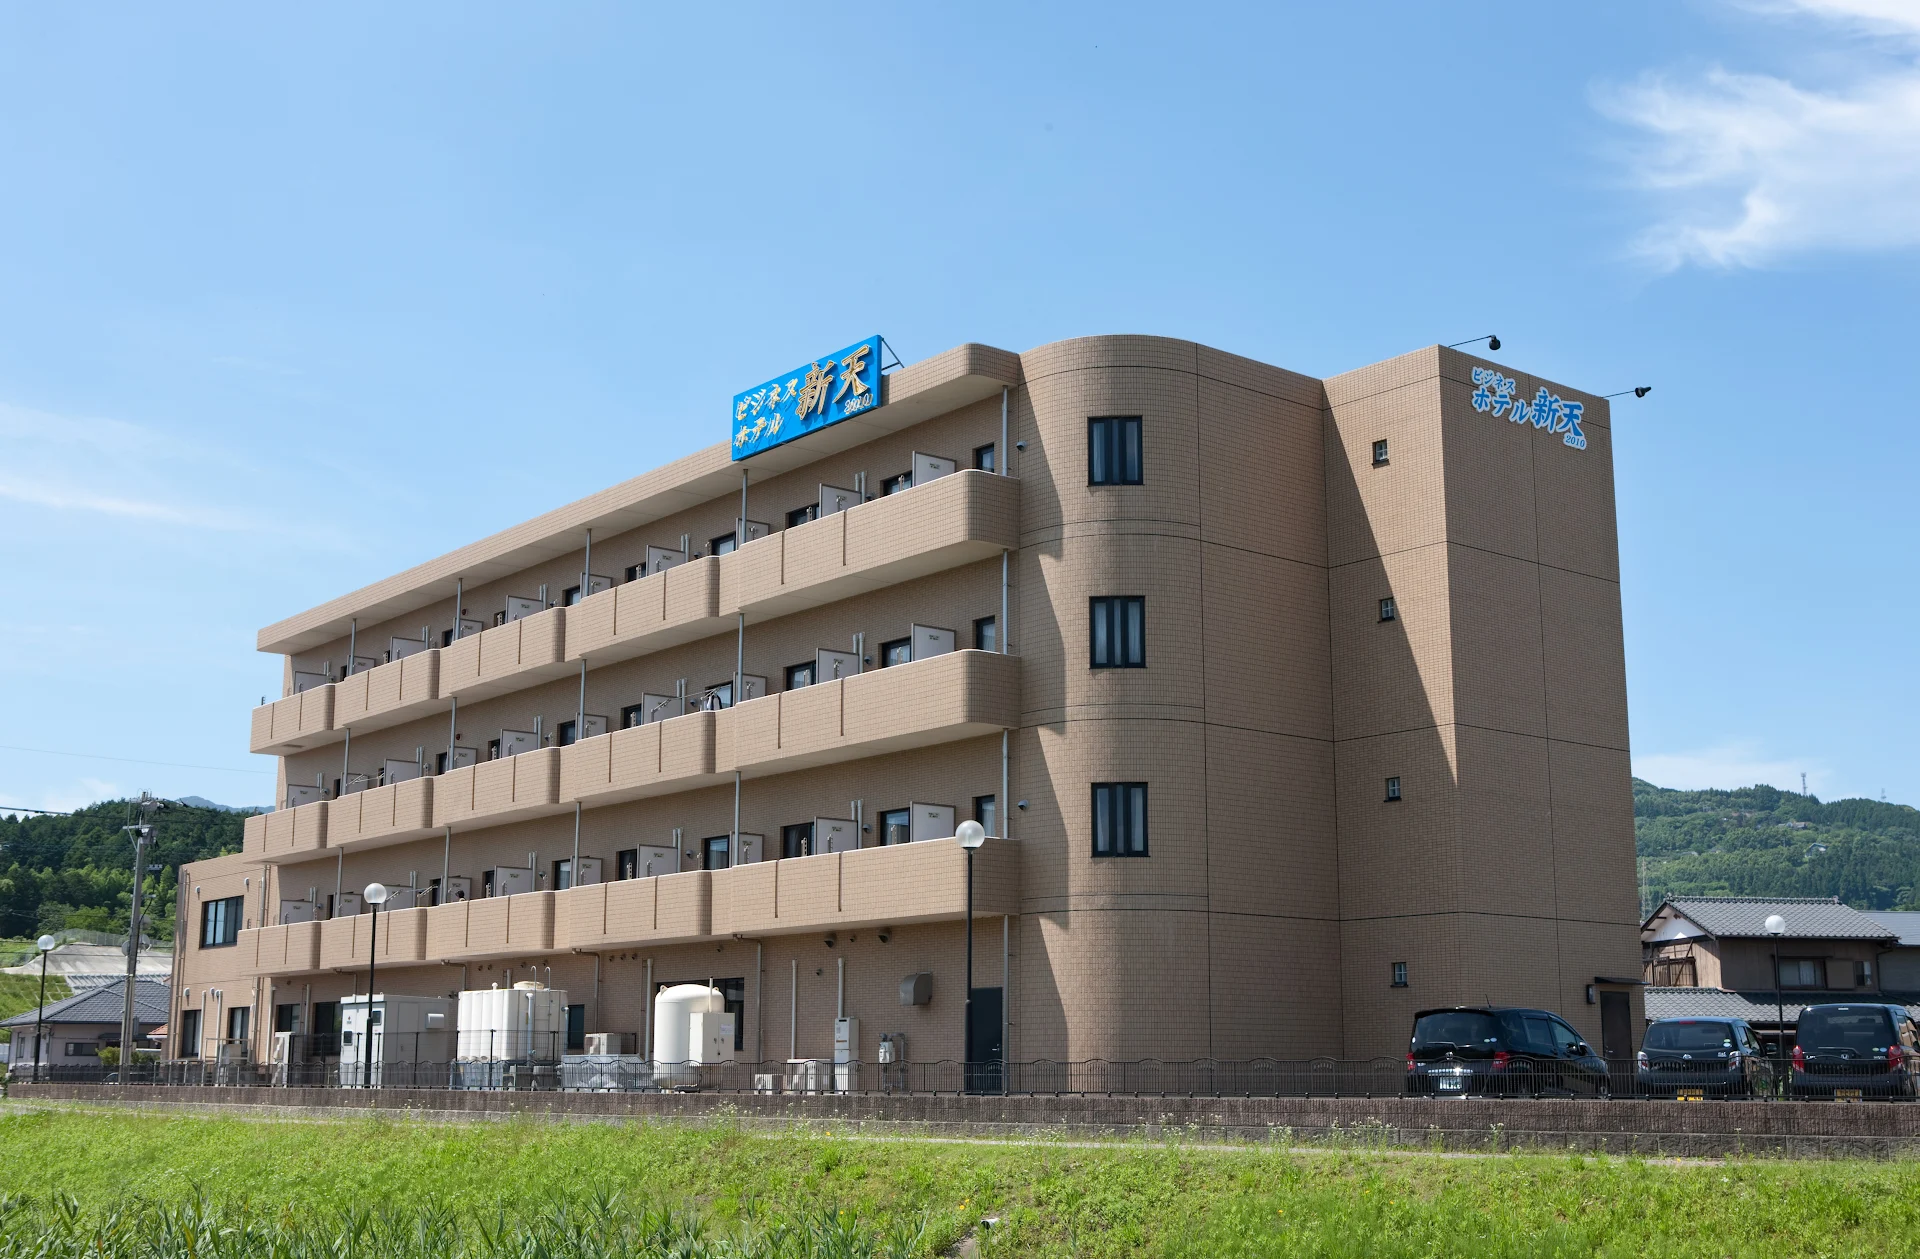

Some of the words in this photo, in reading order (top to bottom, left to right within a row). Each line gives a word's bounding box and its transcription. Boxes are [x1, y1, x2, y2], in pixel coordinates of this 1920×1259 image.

[796, 344, 870, 421] 新天
[1472, 367, 1515, 394] ビジネス
[736, 378, 798, 420] ビジネス
[1473, 387, 1530, 423] ホテル
[1531, 388, 1584, 437] 新天
[734, 413, 784, 448] ホテル
[1564, 434, 1586, 449] 2010
